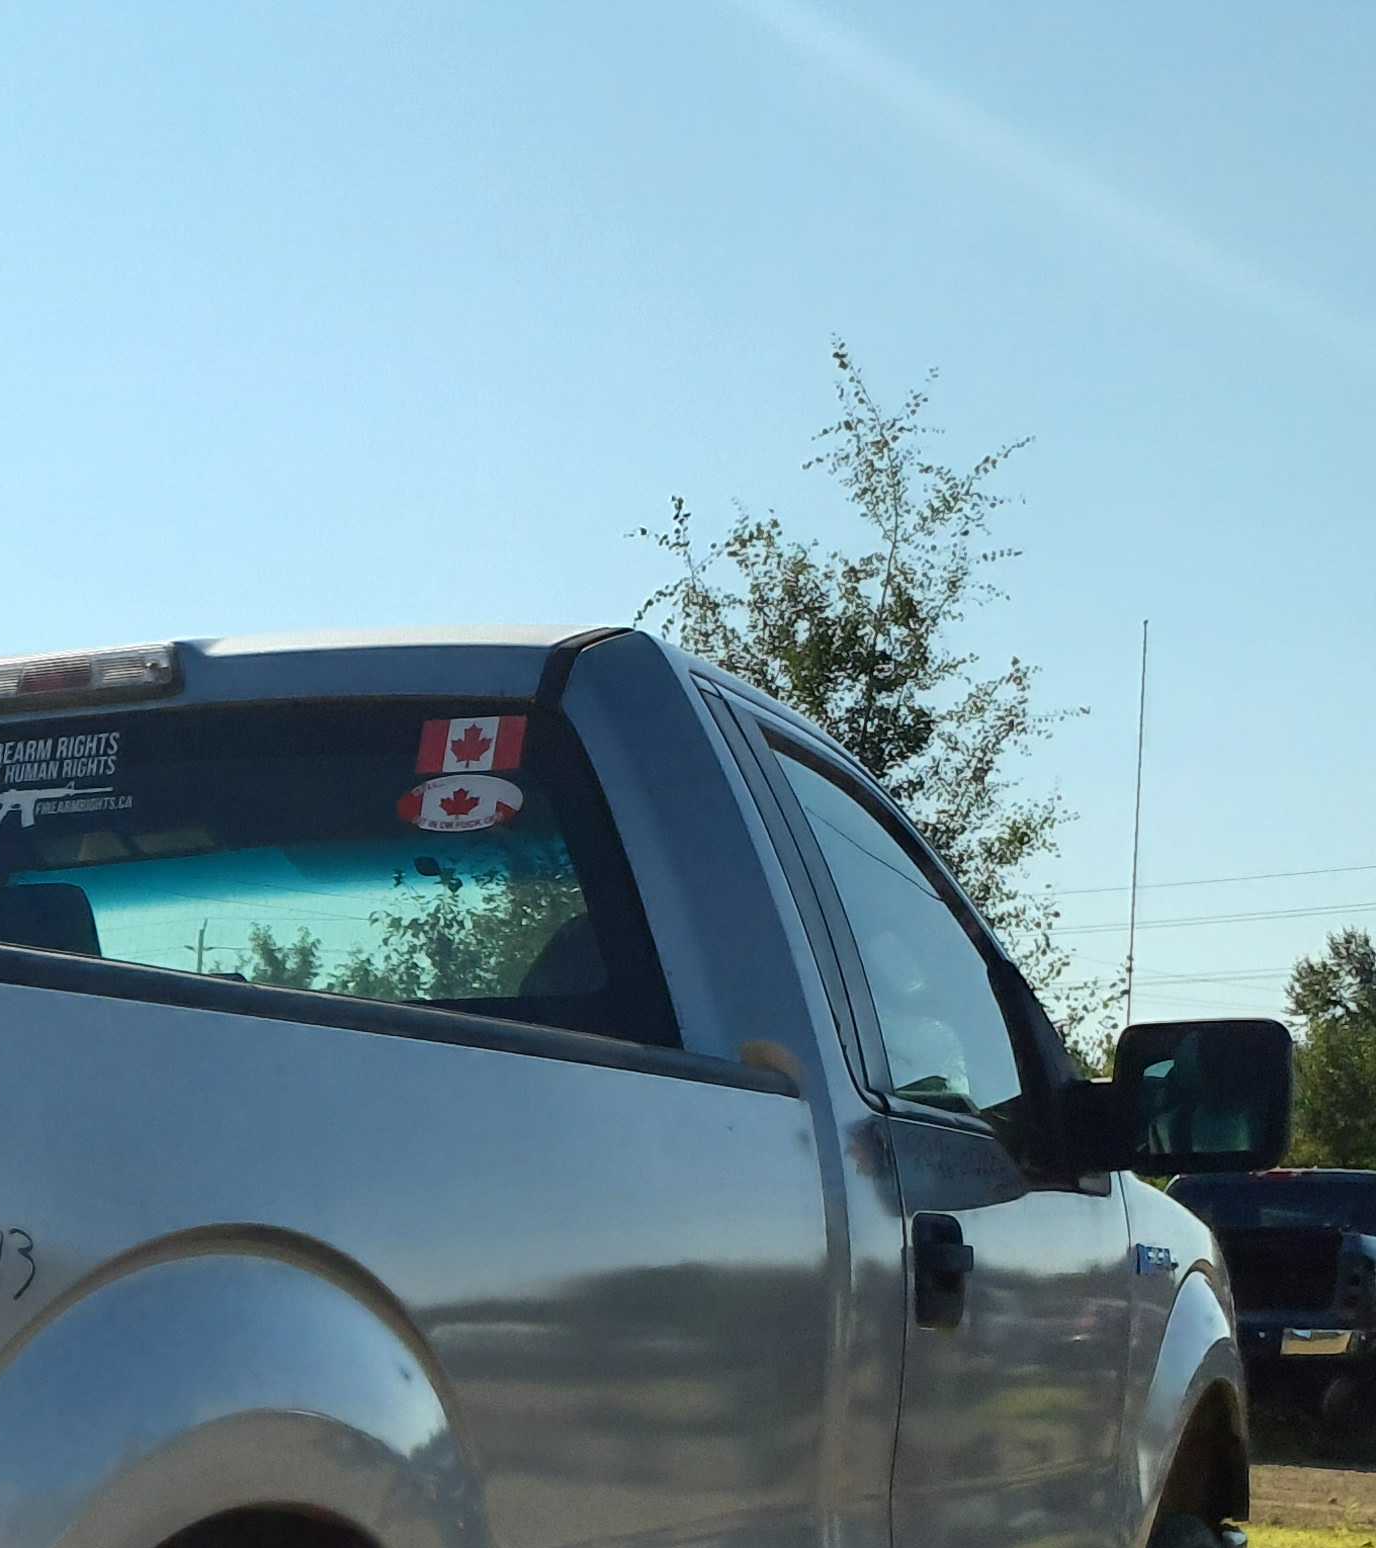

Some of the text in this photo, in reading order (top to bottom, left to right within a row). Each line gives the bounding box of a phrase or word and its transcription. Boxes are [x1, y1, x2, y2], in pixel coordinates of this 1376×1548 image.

[55, 732, 120, 759] RIGHTS
[4, 761, 58, 784] HUMAN
[63, 756, 117, 777] RIGHTS
[34, 795, 133, 816] FIREARMRIGHTS.CA
